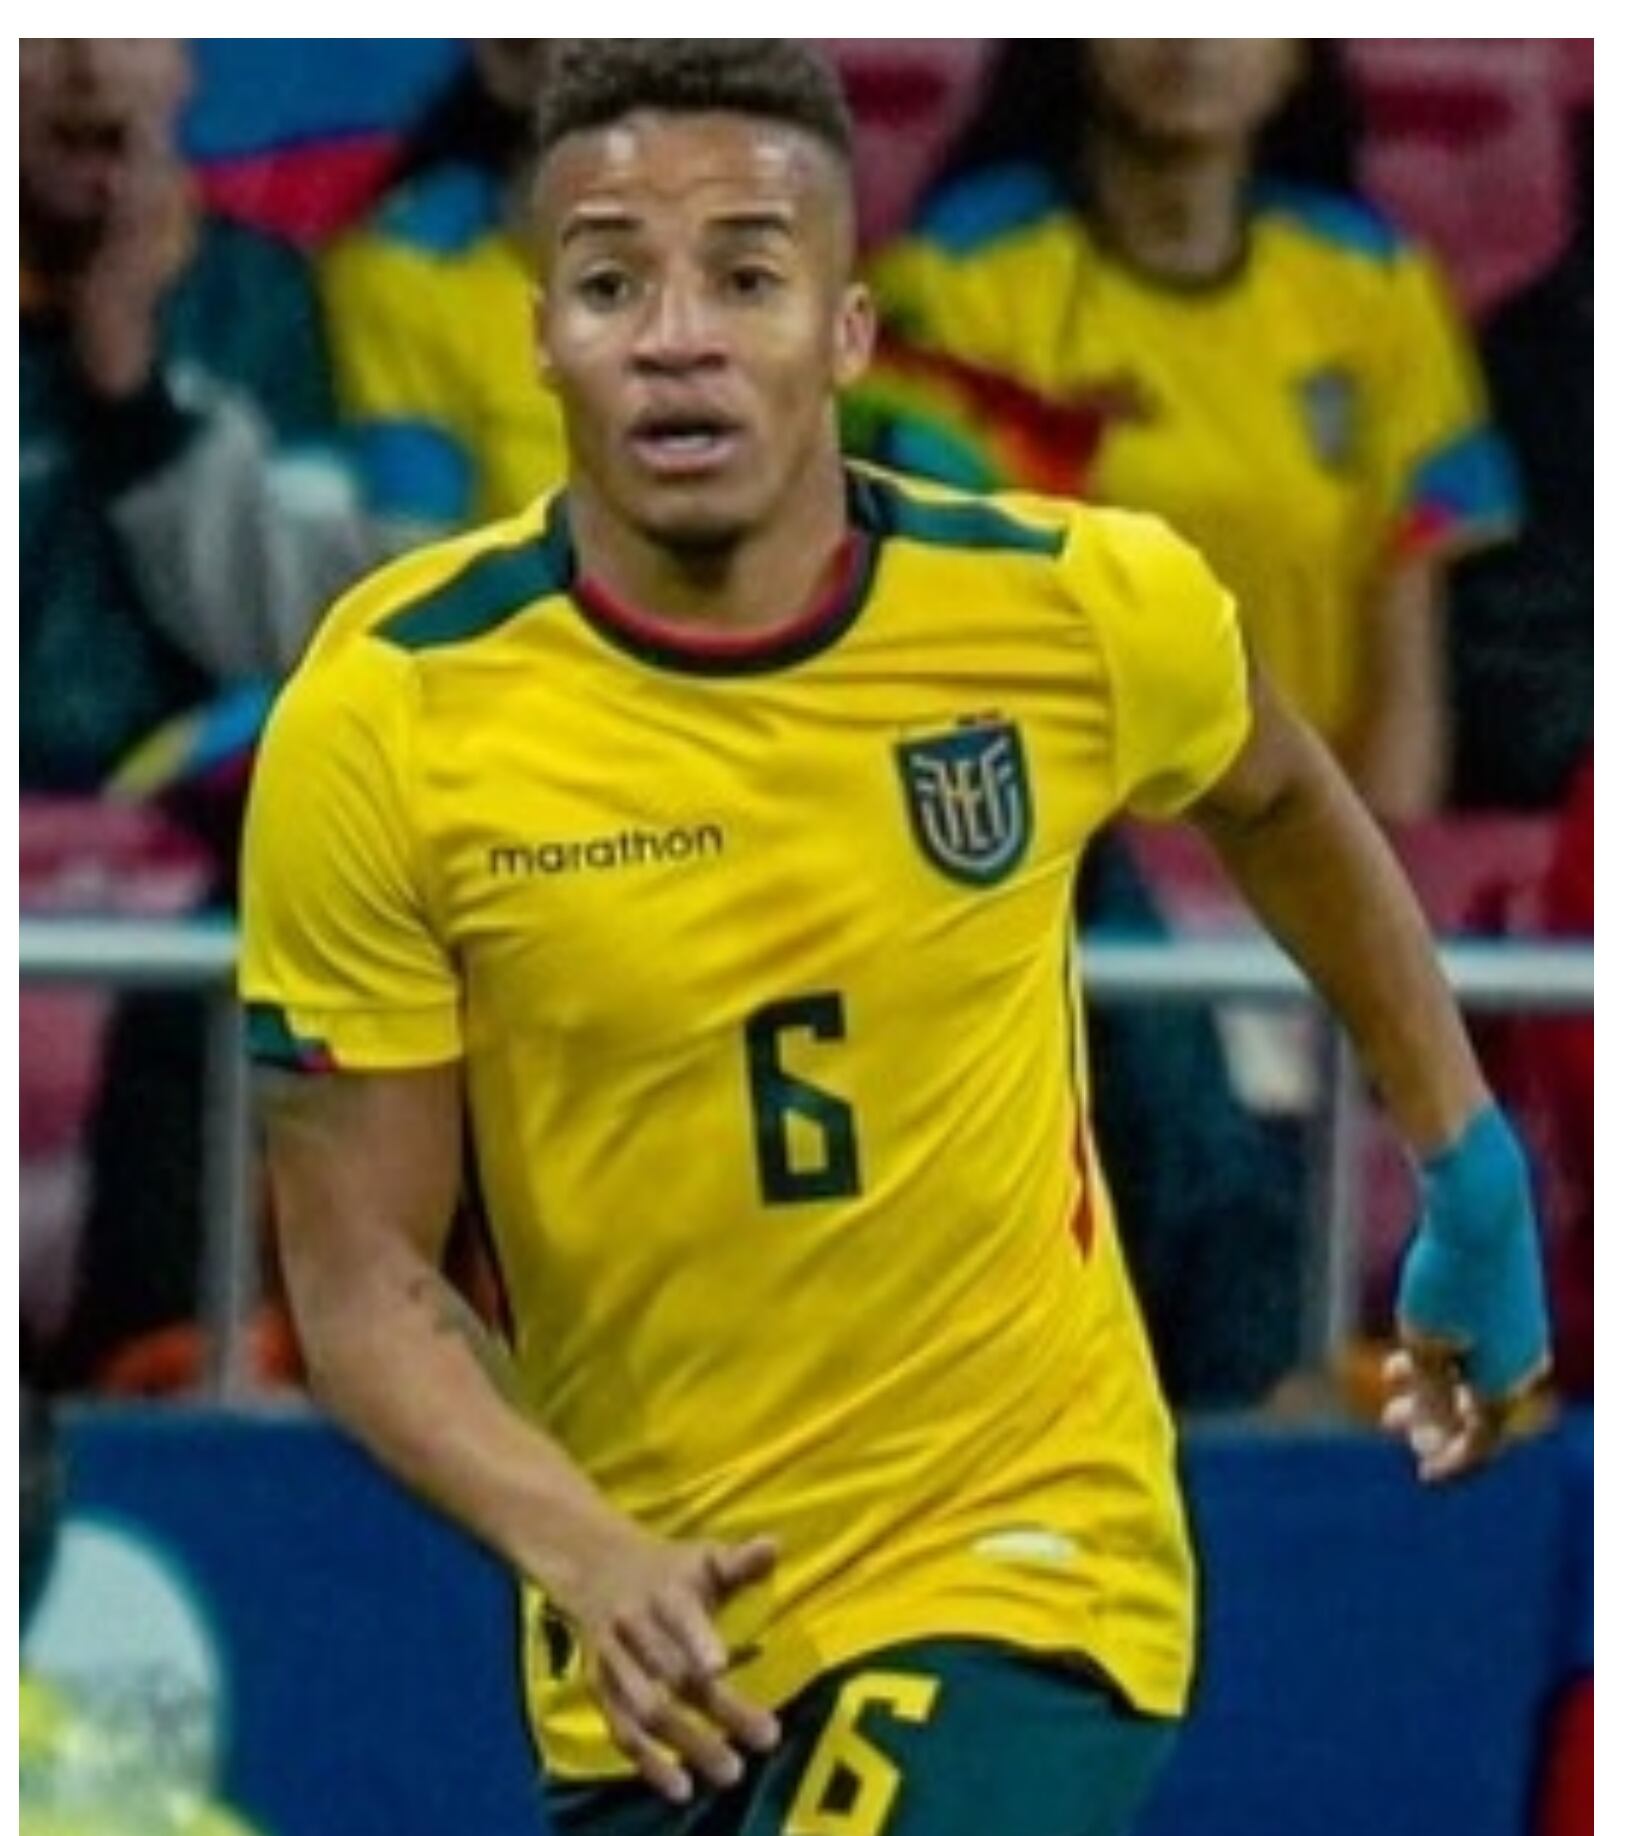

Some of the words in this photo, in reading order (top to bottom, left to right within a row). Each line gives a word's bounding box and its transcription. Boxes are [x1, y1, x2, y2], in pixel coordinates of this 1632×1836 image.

[488, 822, 724, 876] marathon
[744, 990, 862, 1207] 6
[782, 1674, 940, 1836] 6
